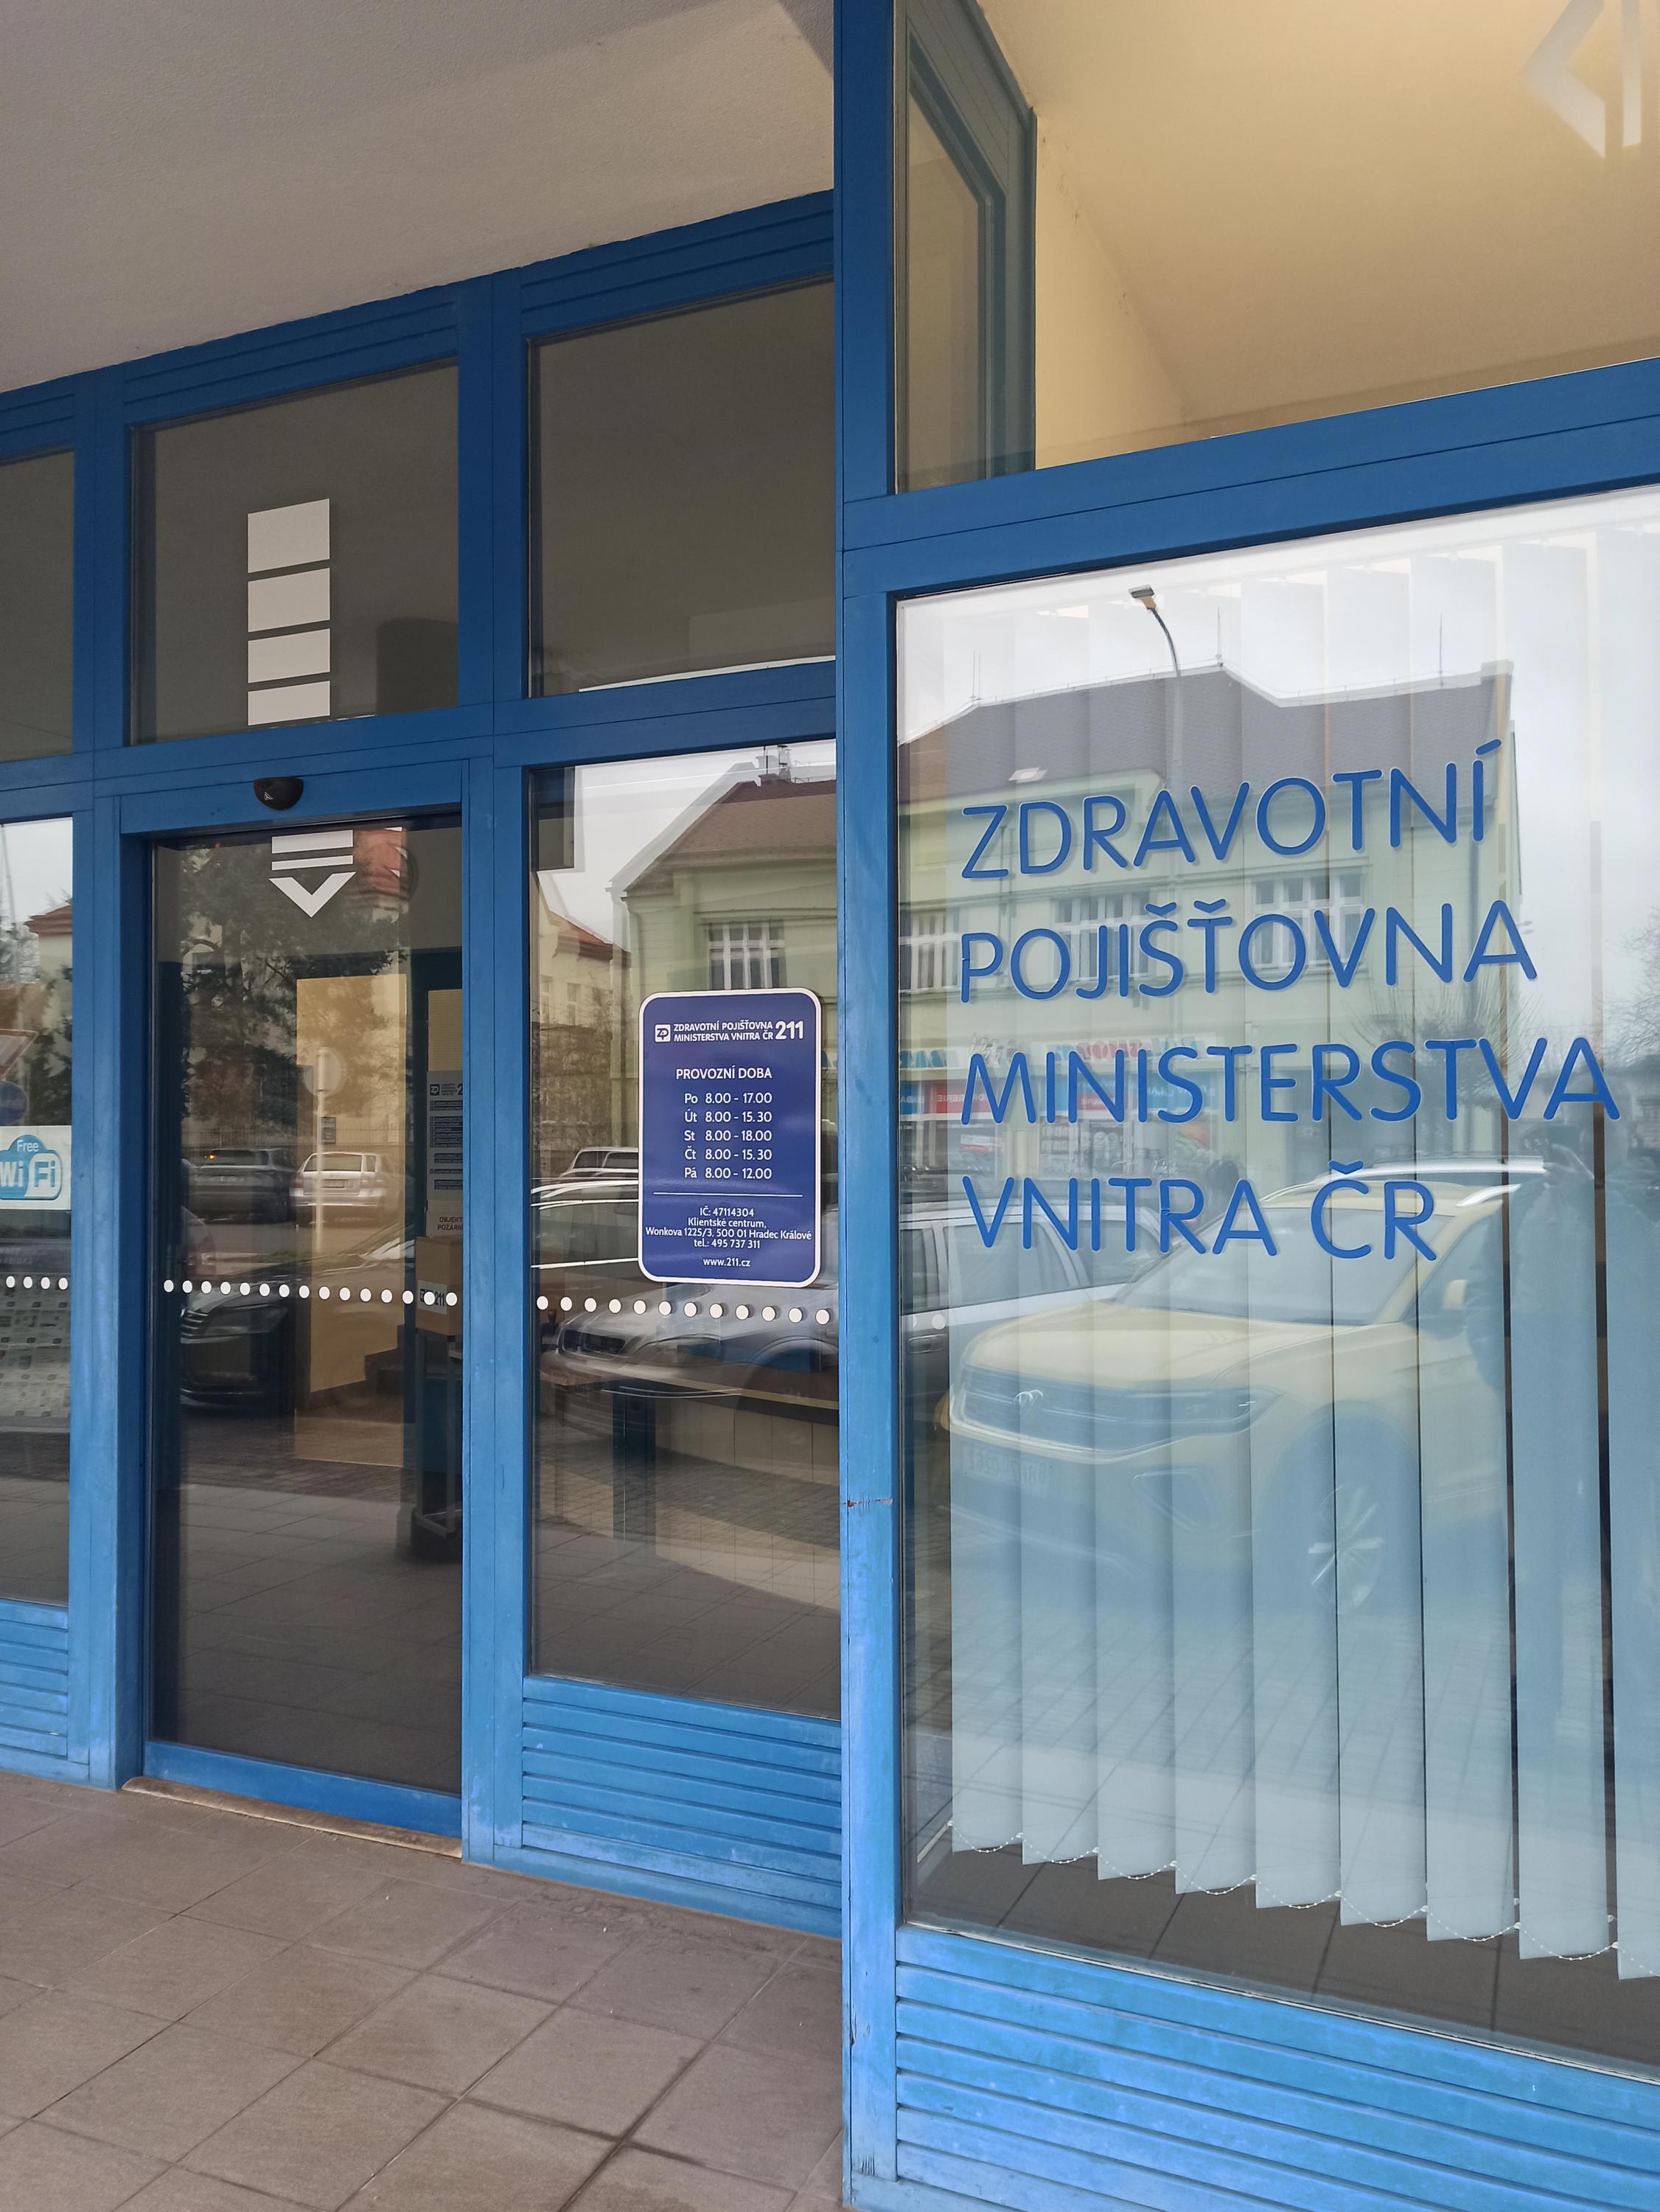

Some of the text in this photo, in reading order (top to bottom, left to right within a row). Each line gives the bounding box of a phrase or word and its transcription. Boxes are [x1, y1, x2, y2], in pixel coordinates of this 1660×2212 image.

[961, 739, 1502, 879] ZDRAVOTNÍ
[960, 899, 1537, 1004] POJIŠŤOVNA
[673, 1019, 773, 1032] ZDRAVOTNÍ POJIŠŤOVNA
[775, 1020, 803, 1040] 211
[674, 1029, 774, 1042] MINISTERSTVA VNITRA ČR
[676, 1065, 773, 1079] PROVOZNÍ DOBA
[961, 1037, 1620, 1124] MINISTERSTVA
[685, 1093, 698, 1104] Po
[705, 1093, 731, 1104] 8.00
[743, 1092, 773, 1104] 17.00
[685, 1108, 697, 1122] Út
[705, 1111, 731, 1122] 8.00
[684, 1130, 695, 1141] St
[705, 1130, 731, 1141] 8.00
[742, 1130, 772, 1141] 18.00
[16, 1139, 39, 1152] Free
[685, 1145, 697, 1160] Čt
[705, 1149, 731, 1160] 8.00
[685, 1167, 697, 1178] Pá
[705, 1167, 731, 1179] 8.00
[742, 1167, 772, 1179] 12.00
[700, 1206, 755, 1217] IČ: 47114304
[961, 1160, 1437, 1261] VNITRA ČR
[688, 1217, 767, 1229] Klientské centrum,
[645, 1226, 683, 1237] Wonkova
[716, 1228, 735, 1238] 500
[749, 1229, 778, 1239] Hradec
[780, 1230, 812, 1240] Králové
[711, 1239, 728, 1248] 495
[730, 1239, 746, 1248] 737
[747, 1239, 760, 1249] 311
[702, 1257, 750, 1267] www.211.cz
